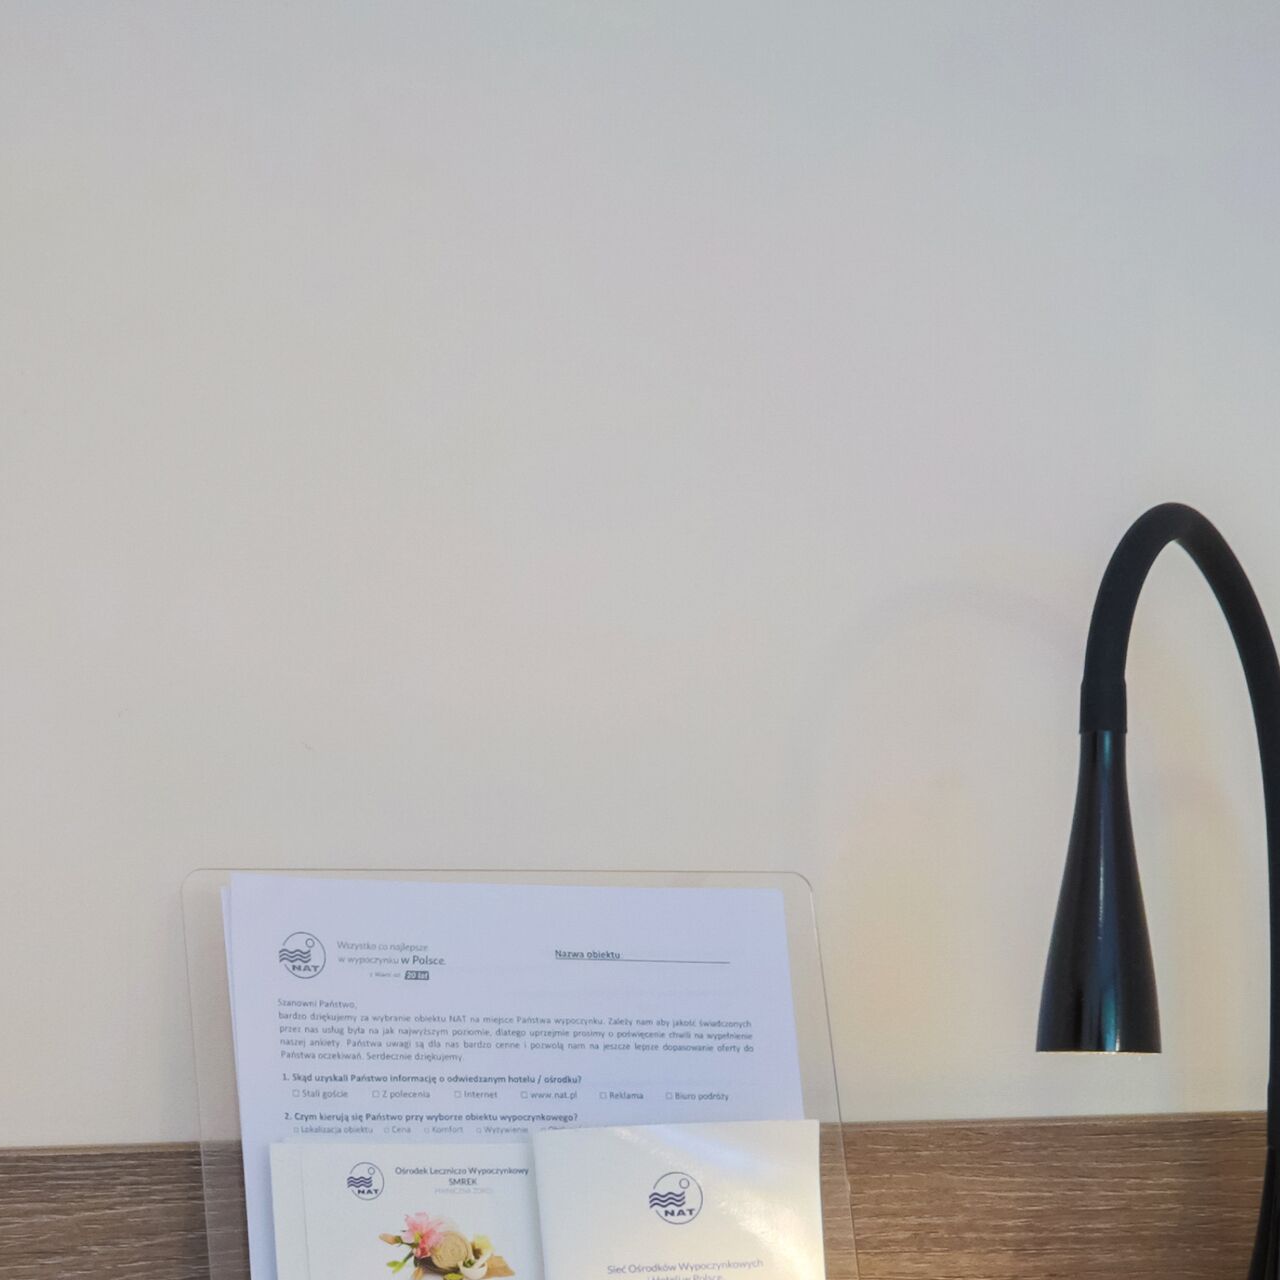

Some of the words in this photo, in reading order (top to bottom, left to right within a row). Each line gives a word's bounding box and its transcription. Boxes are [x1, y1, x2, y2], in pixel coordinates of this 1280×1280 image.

[337, 941, 377, 951] Wszystko
[390, 943, 428, 952] najlepsze
[555, 949, 584, 959] Nazwa
[348, 957, 399, 965] wypoczynku
[413, 956, 446, 965] Polsce.
[277, 999, 317, 1008] Szanowni
[319, 1000, 357, 1009] Państwo,
[279, 1012, 307, 1020] bardzo
[310, 1013, 356, 1023] dziękujemy
[372, 1014, 411, 1023] wybranie
[483, 1016, 514, 1024] miejsce
[608, 1018, 633, 1026] Zależy
[656, 1019, 669, 1027] aby
[699, 1020, 751, 1028] świadczonych
[279, 1026, 301, 1035] przez
[322, 1026, 344, 1035] usług
[347, 1027, 365, 1035] była
[382, 1027, 394, 1035] jak
[398, 1027, 448, 1036] najwyższym
[452, 1028, 492, 1037] poziomie,
[495, 1028, 525, 1037] dlatego
[529, 1030, 569, 1038] uprzejmie
[573, 1030, 604, 1038] prosimy
[617, 1030, 665, 1039] poświęcenie
[669, 1031, 691, 1039] chwili
[707, 1032, 752, 1041] wypełnienie
[280, 1039, 306, 1047] naszej
[386, 1041, 411, 1049] uwagi
[530, 1042, 564, 1050] pozwolą
[634, 1043, 659, 1051] lepsze
[663, 1044, 713, 1052] dopasowanie
[717, 1045, 740, 1053] oferty
[281, 1051, 315, 1059] Państwa
[318, 1052, 364, 1060] oczekiwań.
[292, 1074, 312, 1083] Skąd
[315, 1074, 348, 1083] uzyskali
[351, 1074, 387, 1082] Państwo
[390, 1075, 436, 1084] informację
[447, 1075, 505, 1084] odwiedzanym
[508, 1075, 534, 1083] hotelu
[544, 1075, 582, 1083] ośrodku?
[322, 1090, 347, 1099] goście
[382, 1090, 388, 1098] Z
[390, 1090, 430, 1099] polecenia
[464, 1090, 497, 1098] Internet
[531, 1091, 577, 1100] www.nat.pl
[675, 1092, 696, 1100] Biuro
[698, 1092, 729, 1101] podróży
[294, 1113, 317, 1122] Czym
[319, 1113, 349, 1122] kierują
[351, 1114, 363, 1122] się
[365, 1113, 402, 1121] Państwo
[406, 1114, 424, 1122] przy
[427, 1114, 462, 1122] wyborze
[500, 1113, 577, 1122] wypoczynkowego?
[300, 1126, 341, 1134] Lokalizacja
[395, 1167, 427, 1175] Ośrodek
[430, 1167, 466, 1175] Leczniczo
[468, 1167, 529, 1176] Wypoczynkowy
[449, 1178, 477, 1186] SMREK
[664, 1208, 696, 1217] NAT
[607, 1264, 626, 1274] Sieć
[628, 1262, 676, 1273] Ośrodków
[678, 1258, 763, 1272] Wypoczynkowych
